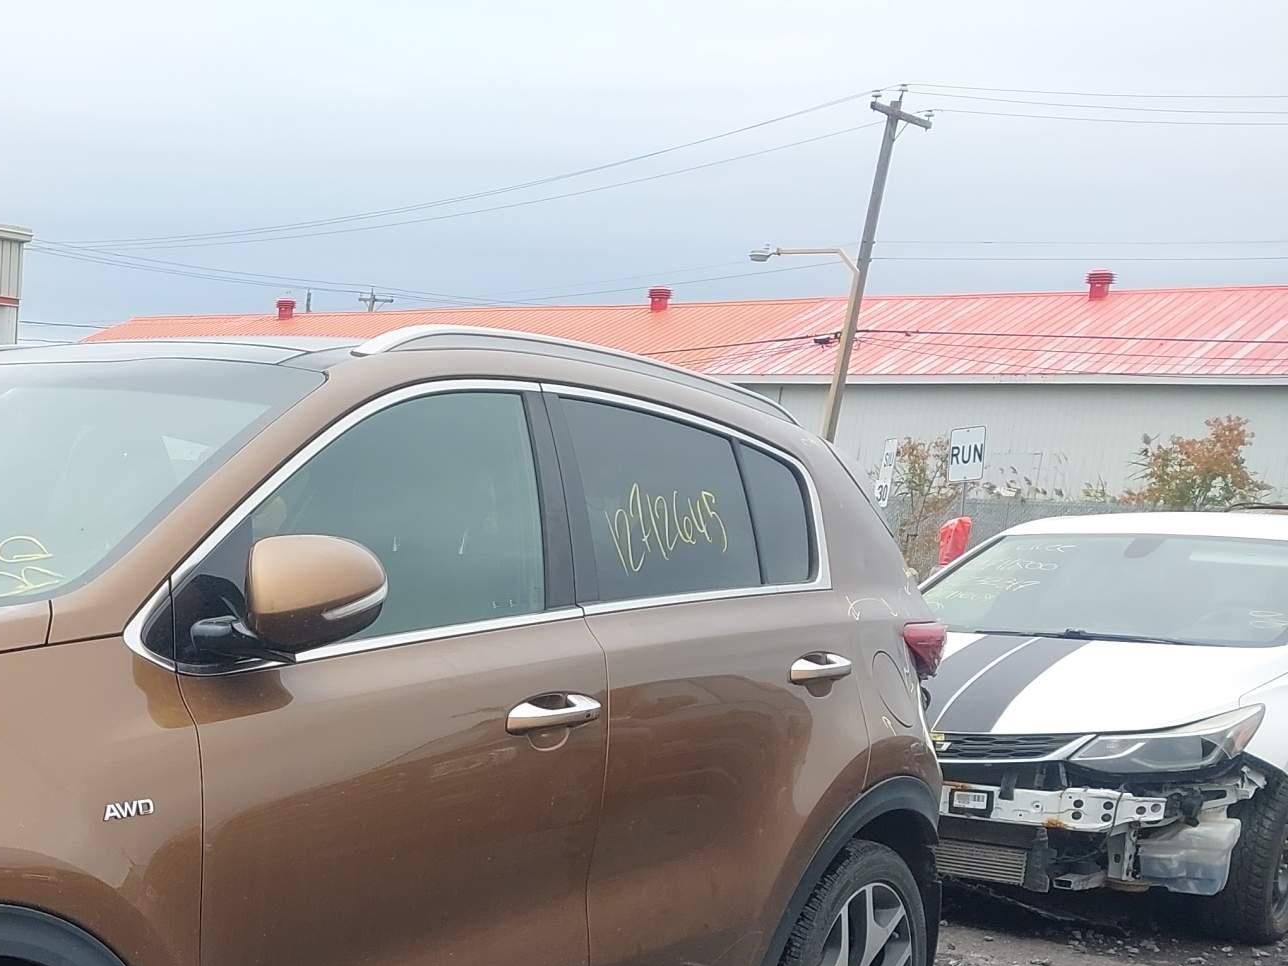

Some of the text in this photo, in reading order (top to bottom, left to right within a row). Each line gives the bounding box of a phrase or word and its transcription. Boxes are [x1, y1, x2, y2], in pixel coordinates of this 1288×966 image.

[950, 443, 983, 465] RUN
[604, 482, 728, 576] 12712645
[103, 798, 154, 821] AWD
